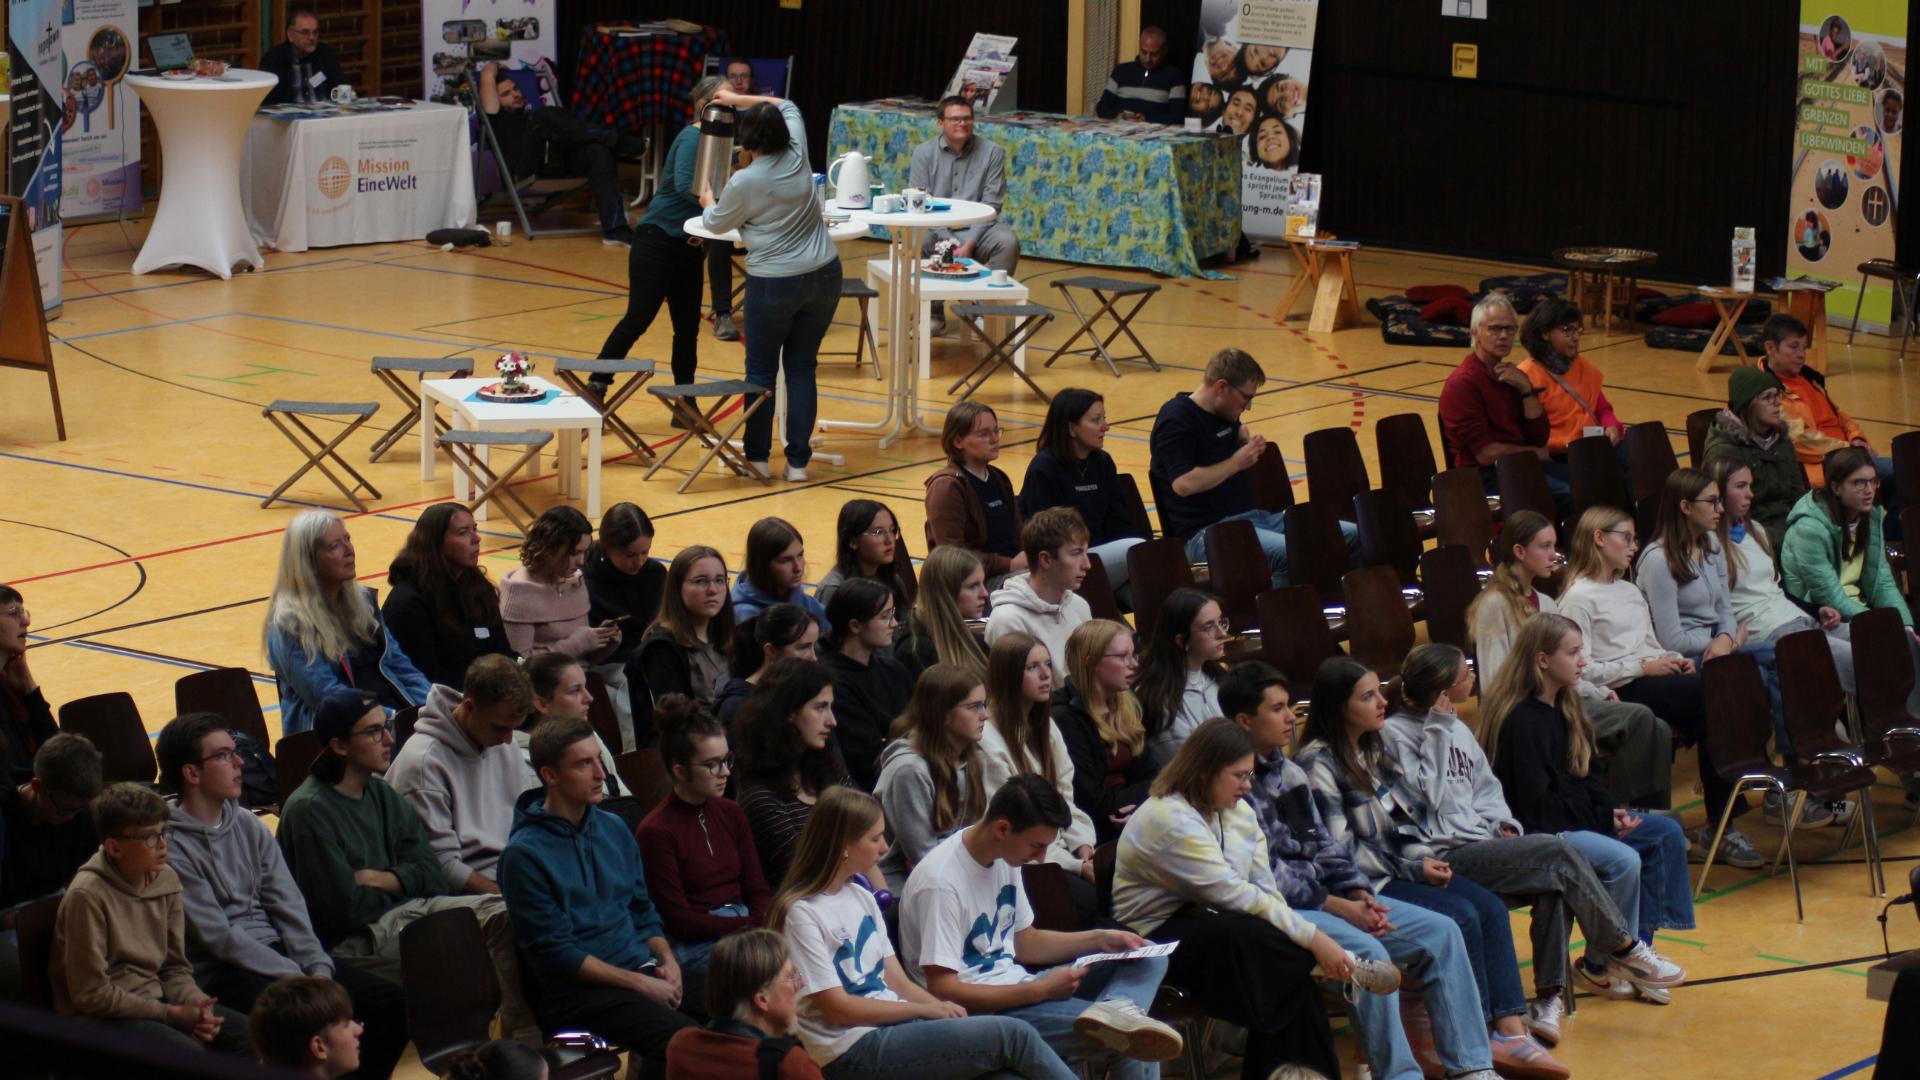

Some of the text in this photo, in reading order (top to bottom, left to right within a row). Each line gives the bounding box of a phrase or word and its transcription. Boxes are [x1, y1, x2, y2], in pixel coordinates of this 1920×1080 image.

[1805, 57, 1824, 70] MIT
[1804, 82, 1868, 104] GOTTES LIEBE
[1803, 108, 1848, 126] GRENZEN
[358, 158, 410, 174] Mission
[357, 175, 417, 193] EineWelt
[1250, 173, 1289, 184] Evangelium
[1259, 191, 1287, 200] Sprache
